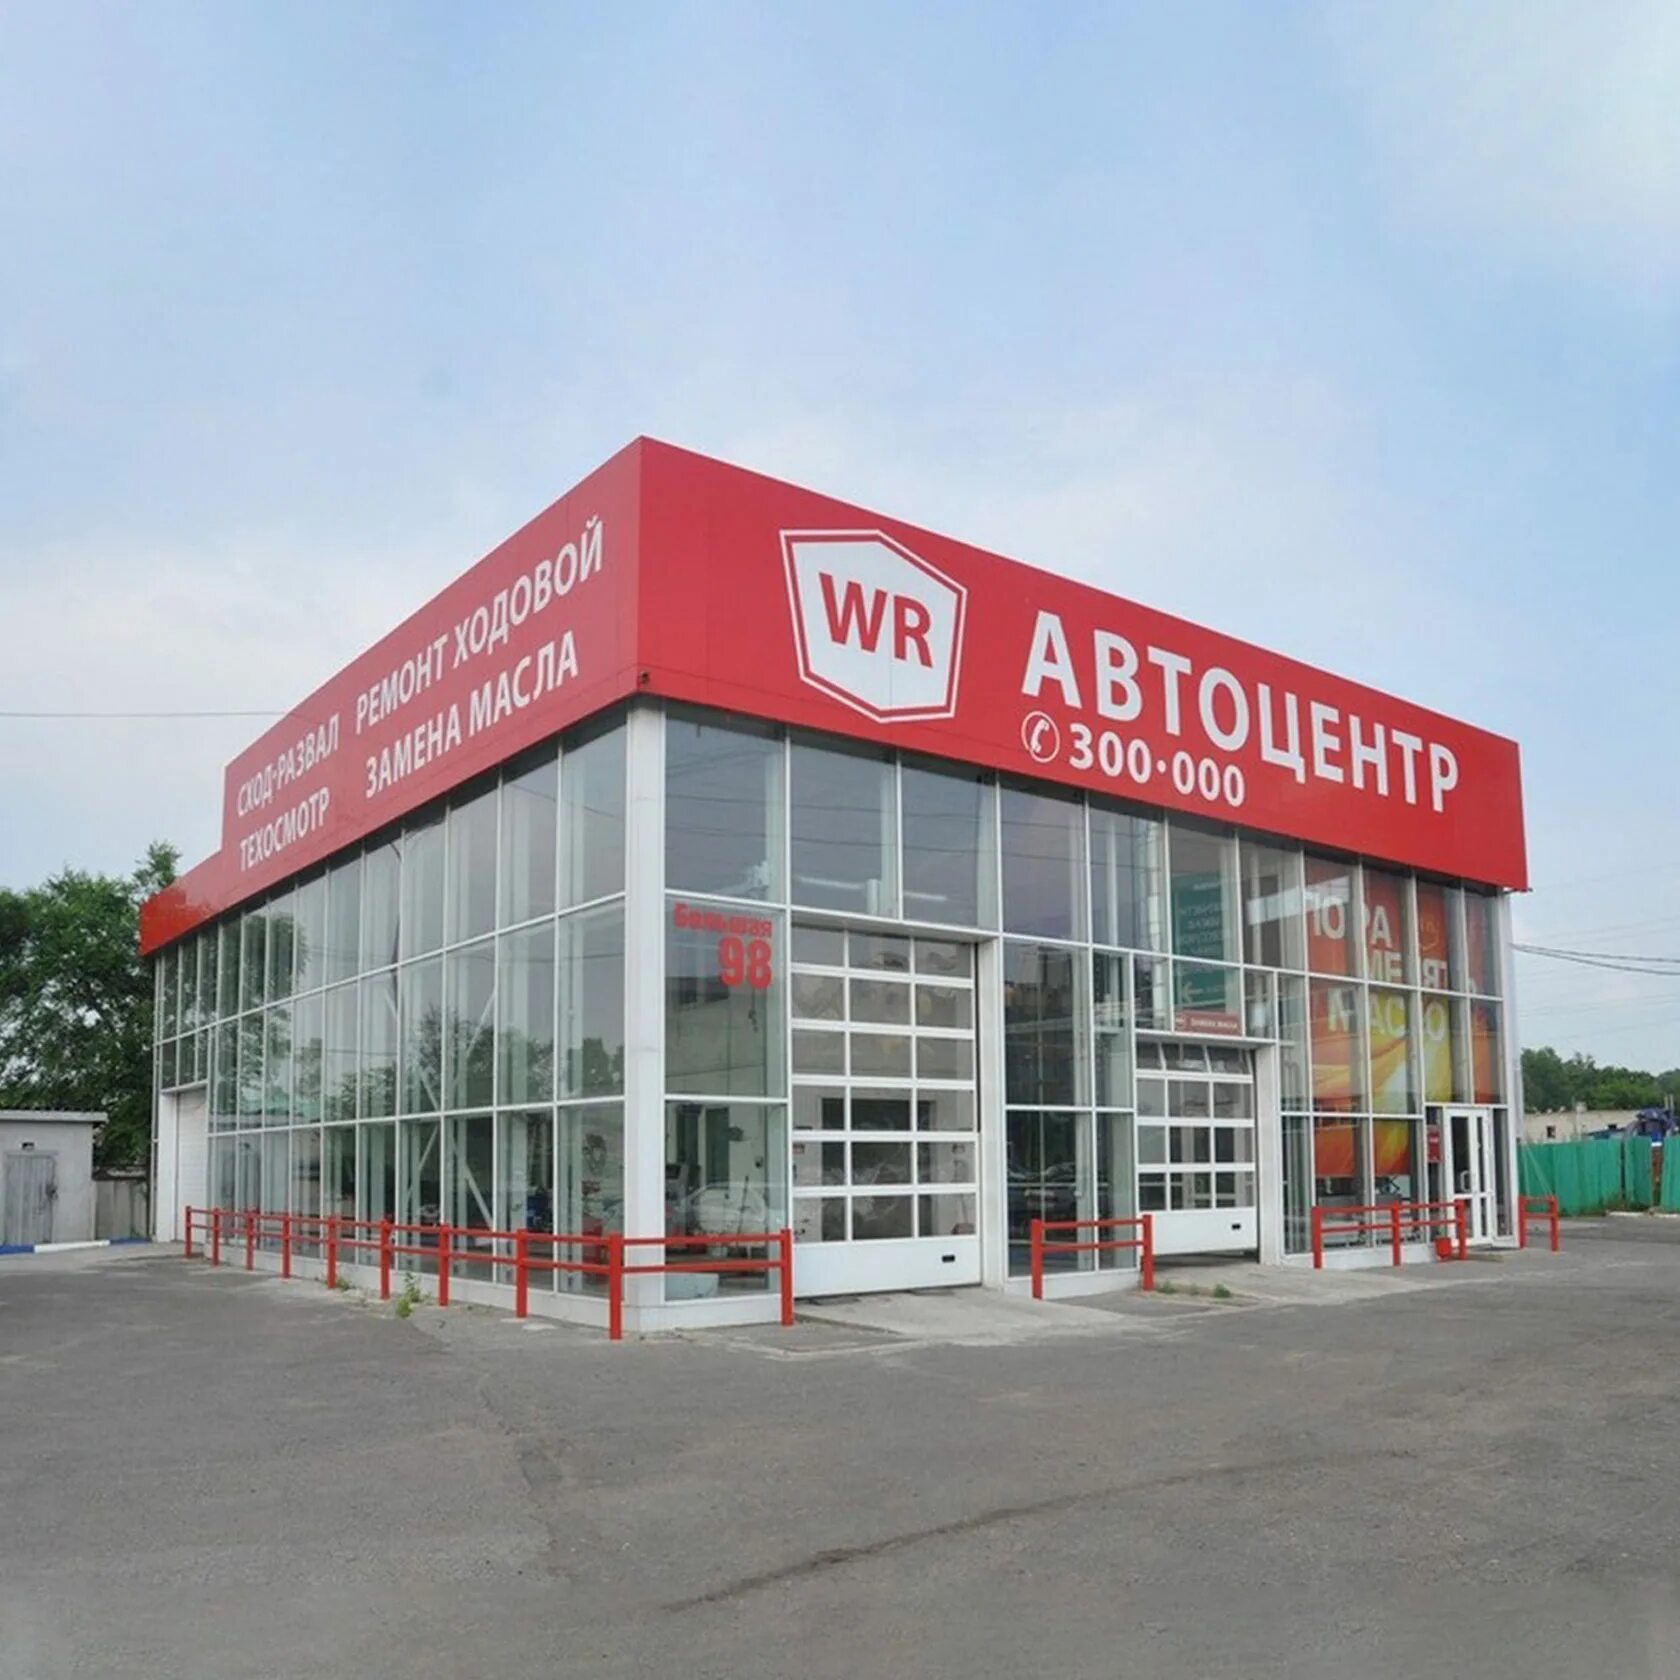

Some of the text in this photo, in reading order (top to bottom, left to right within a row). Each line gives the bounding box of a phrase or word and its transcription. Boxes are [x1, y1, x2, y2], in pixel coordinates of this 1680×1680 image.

[356, 515, 603, 735] РЕМОНТ ХОДОВОЙ
[819, 572, 934, 667] WR
[366, 630, 578, 799] ЗАМЕНА МАСЛА
[1021, 611, 1458, 812] АВТОЦЕНТР
[237, 713, 339, 818] СХОД-РАЗВАЛ
[240, 786, 330, 872] ТЕХОСМОТР
[719, 936, 772, 989] 98
[1328, 987, 1446, 1041] МАСО
